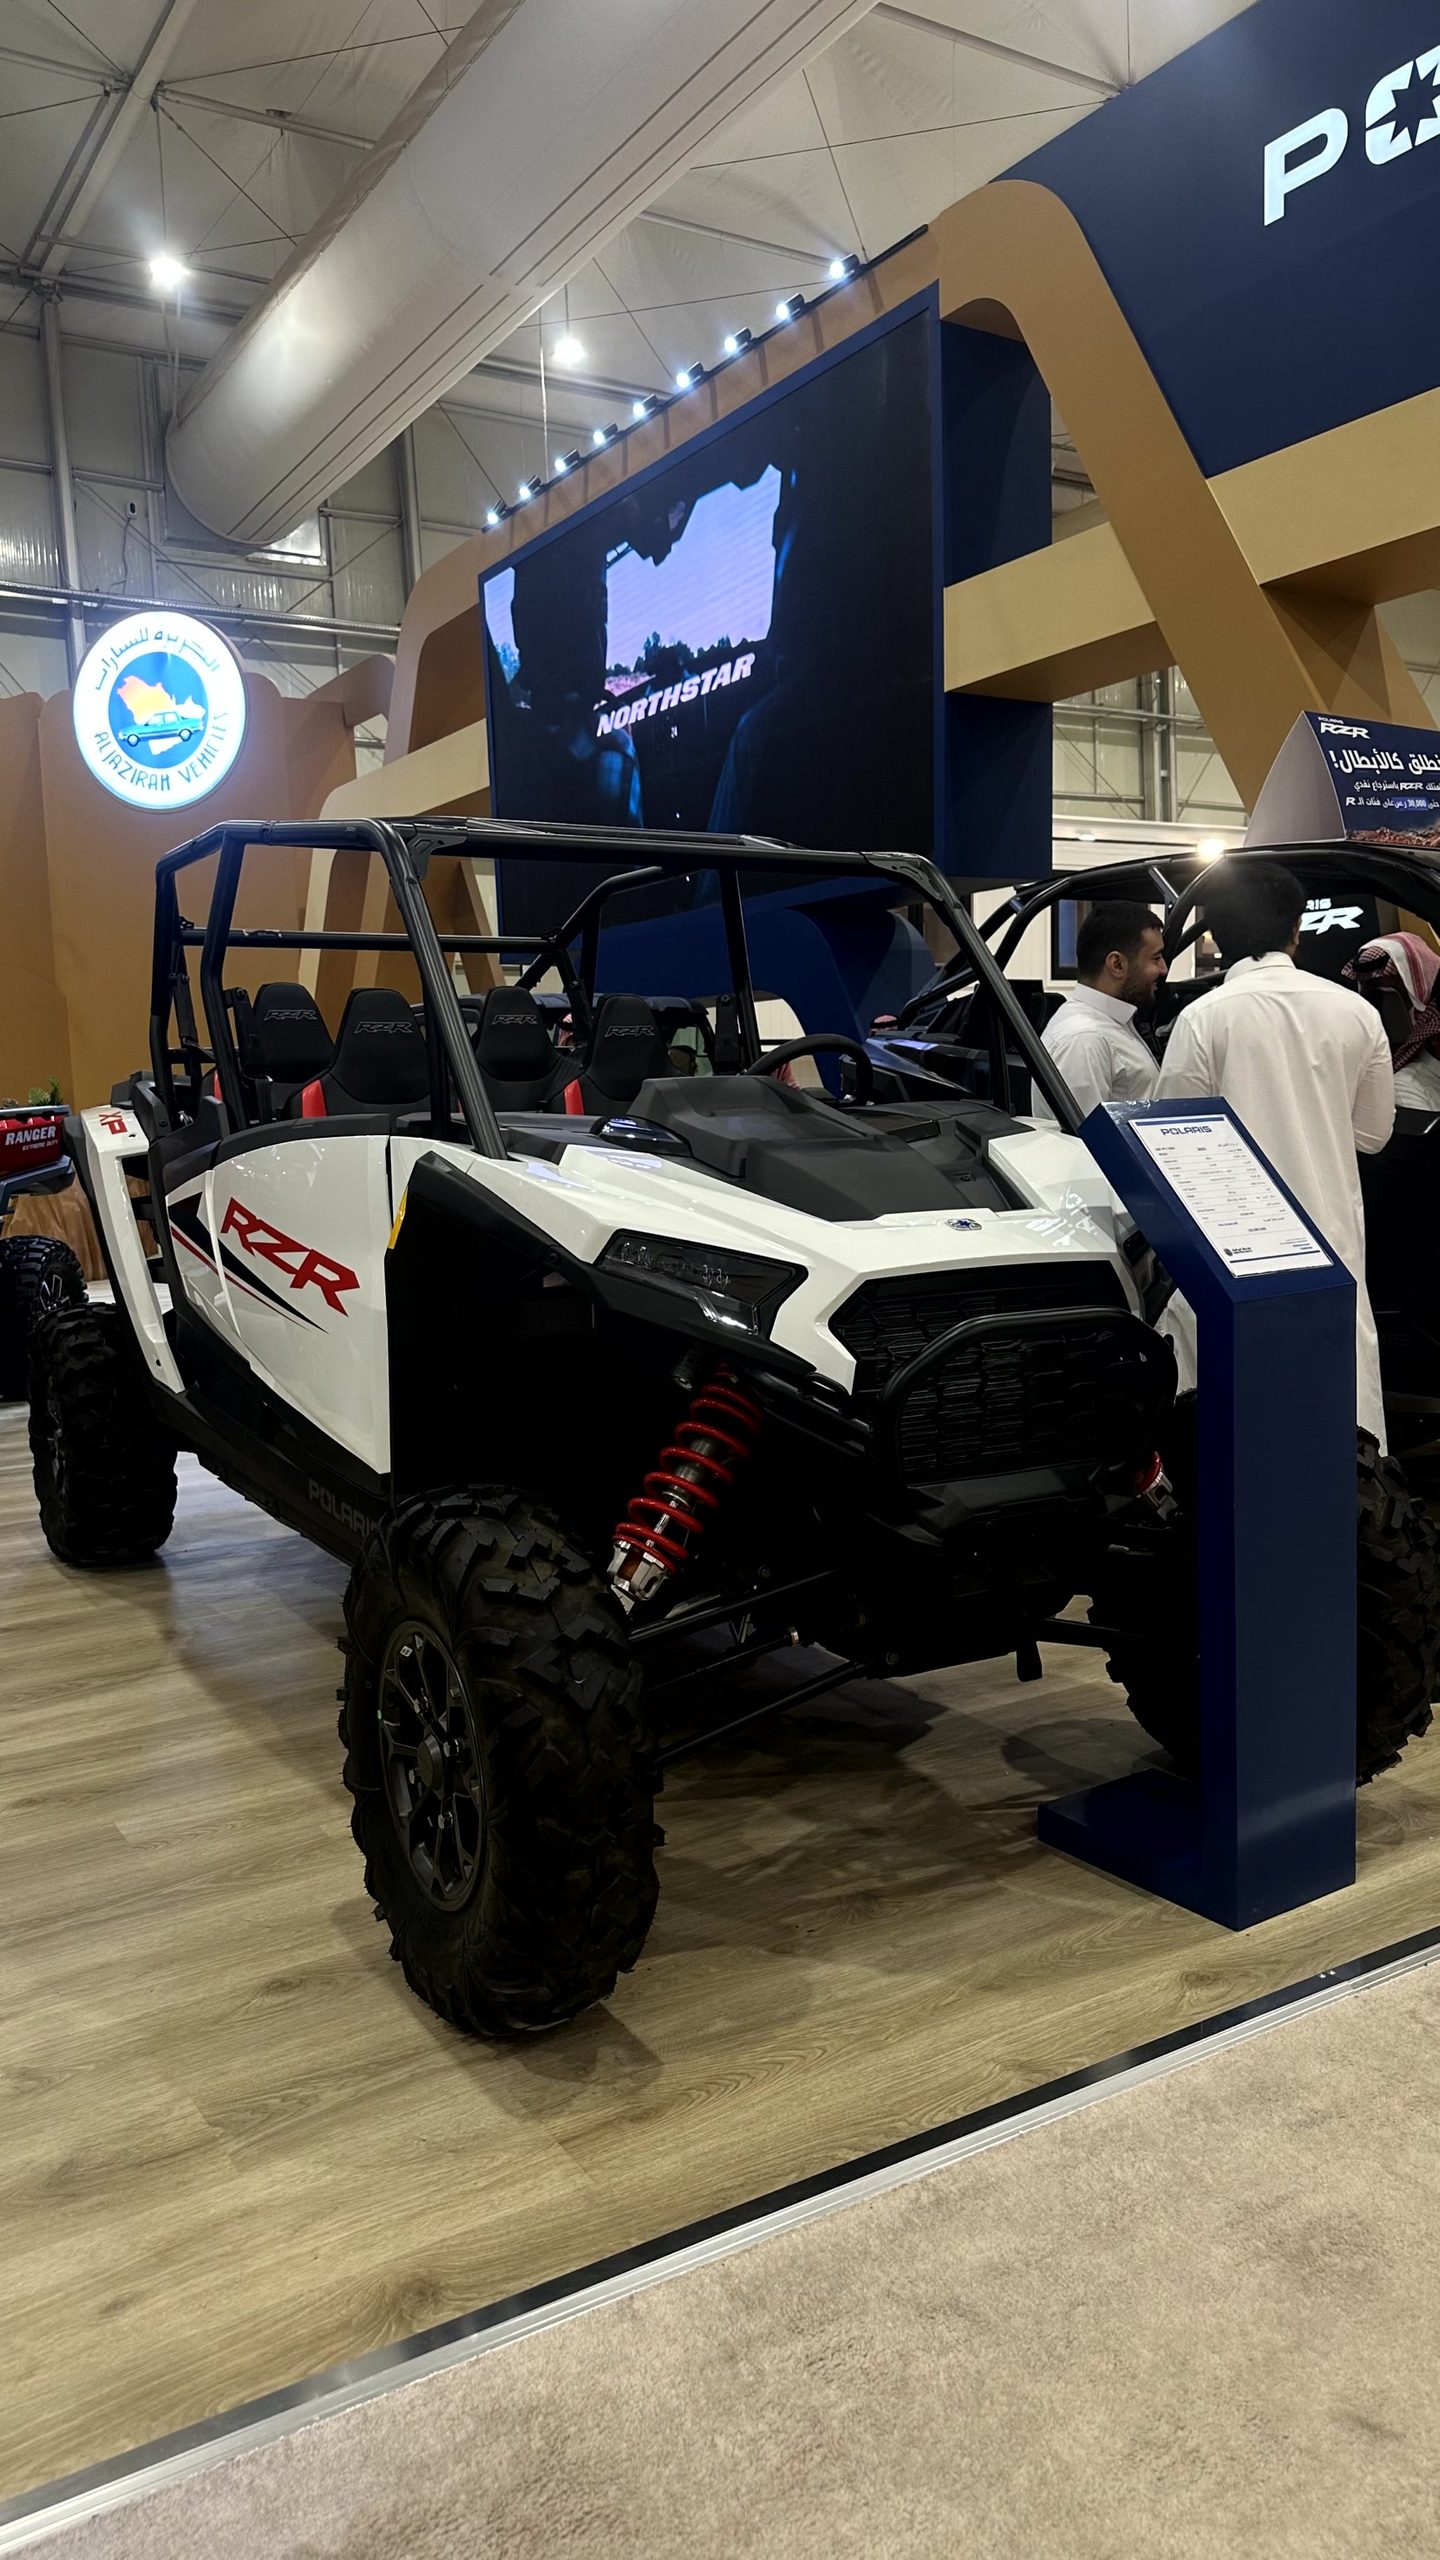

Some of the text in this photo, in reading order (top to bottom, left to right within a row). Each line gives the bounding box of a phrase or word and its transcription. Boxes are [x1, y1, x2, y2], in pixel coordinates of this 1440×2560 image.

[595, 652, 756, 738] NORTHSTAR
[1320, 722, 1371, 740] RZR
[177, 711, 228, 784] VEHICLES
[1328, 748, 1405, 775] كالأبطال!
[1400, 782, 1424, 791] RZR
[1345, 797, 1356, 806] R
[1299, 905, 1364, 935] ZR
[264, 1009, 318, 1021] RZR
[491, 1014, 539, 1025] RZR
[353, 1021, 414, 1034] RZR
[604, 1025, 655, 1037] RZR
[98, 1111, 129, 1135] XP
[1160, 1125, 1213, 1136] POLARIS
[5, 1125, 57, 1146] RANGER
[219, 1196, 361, 1318] RZR
